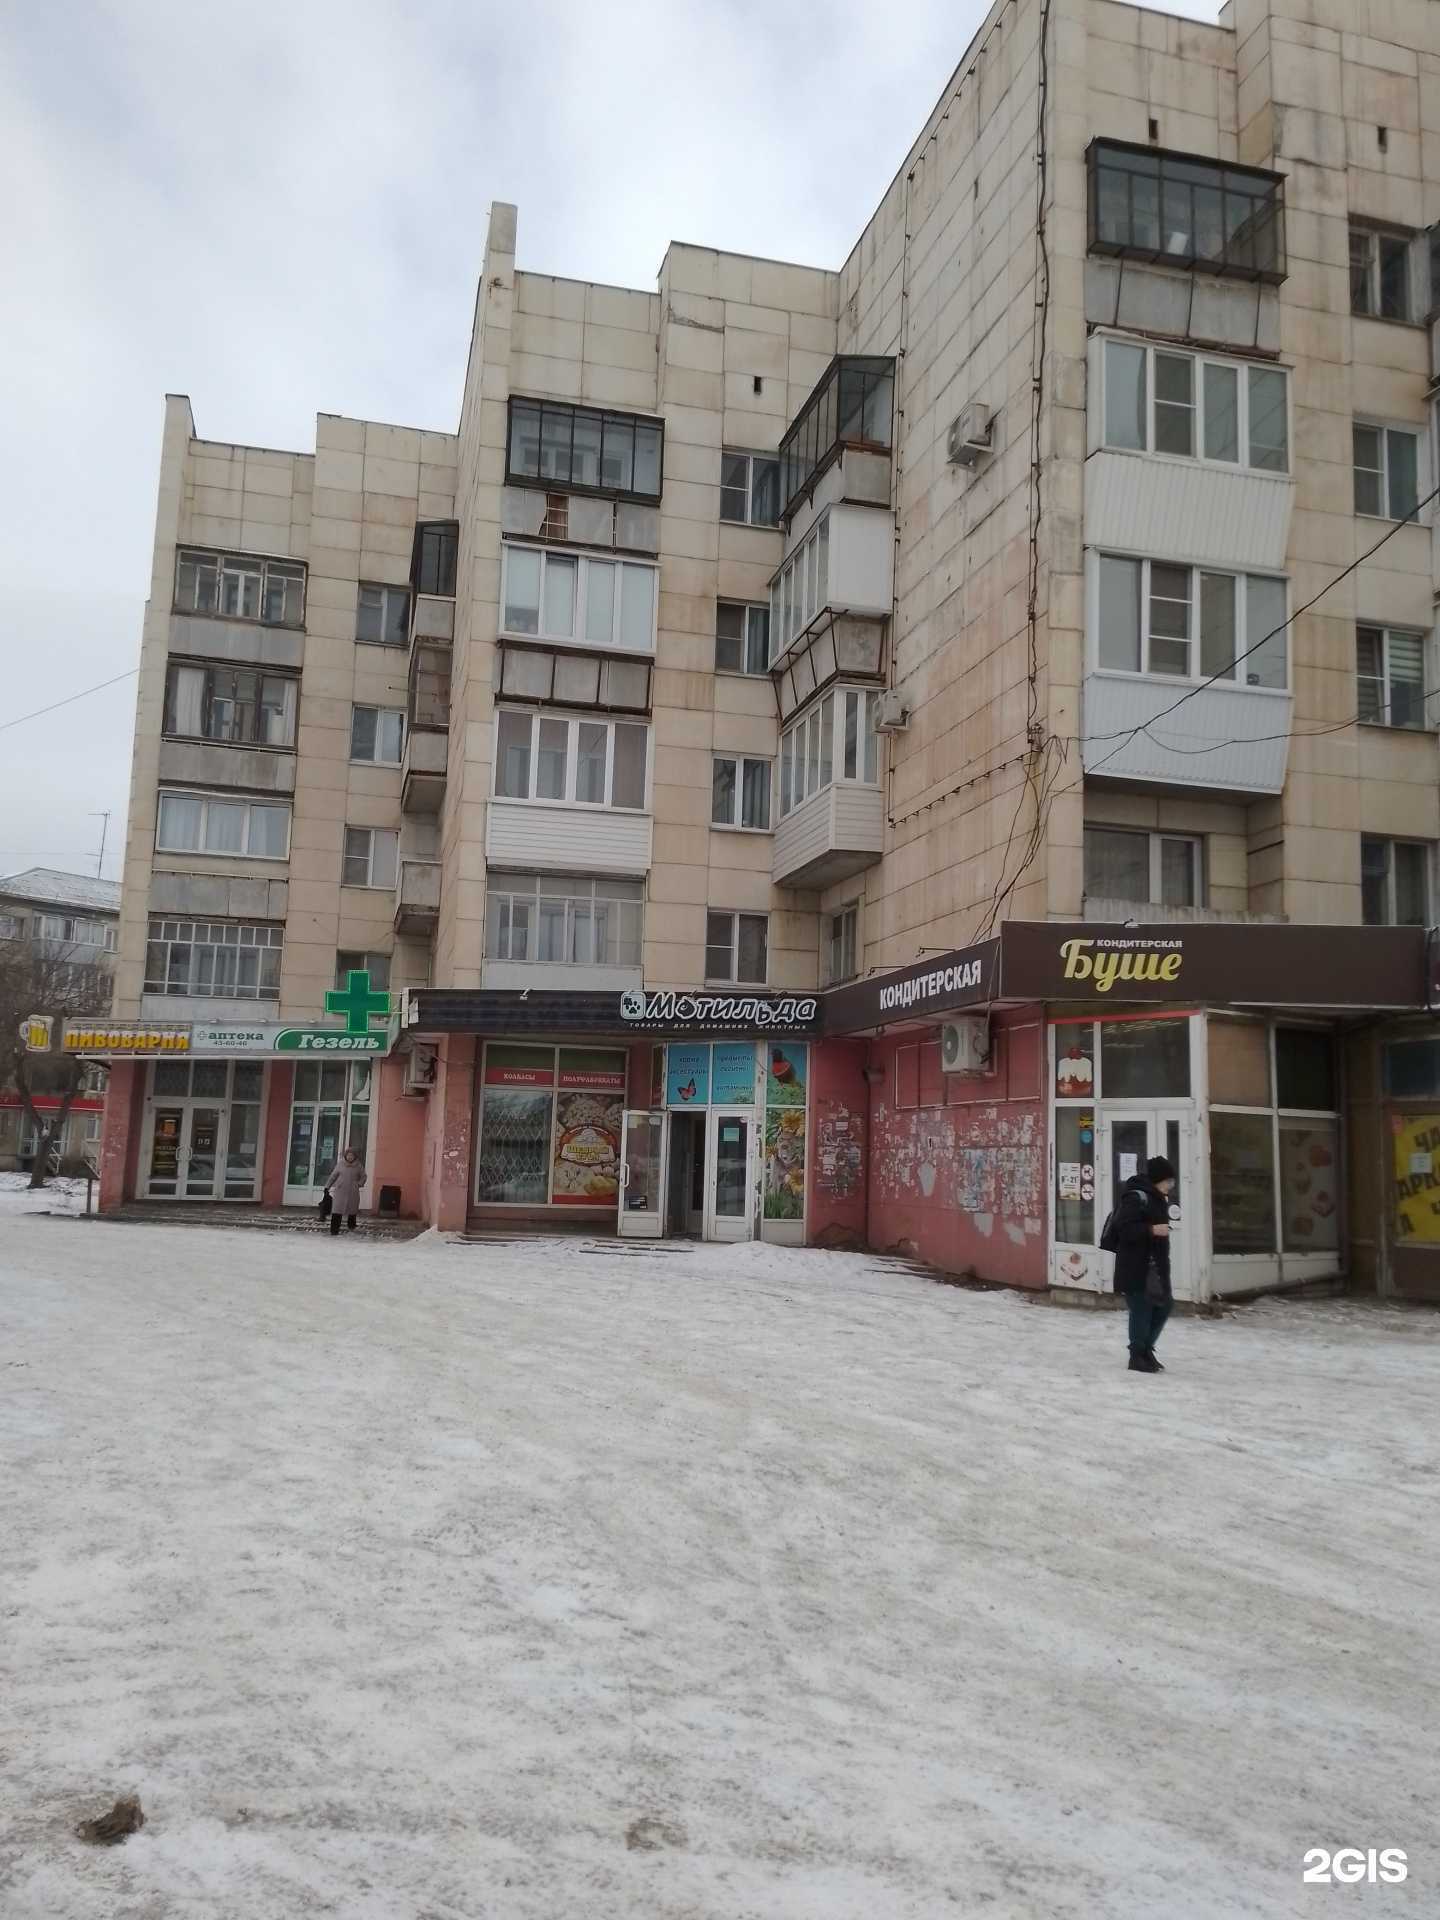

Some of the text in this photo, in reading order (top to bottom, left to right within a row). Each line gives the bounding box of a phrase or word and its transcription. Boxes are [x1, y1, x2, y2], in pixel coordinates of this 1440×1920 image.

[1096, 938, 1183, 949] КОНДИТЕРСКАЯ
[1059, 938, 1183, 992] Буше
[879, 958, 982, 1010] КОНДИТЕРСКАЯ
[645, 991, 818, 1025] Мотильда
[64, 1029, 191, 1051] ПИВОВАРНЯ
[207, 1030, 265, 1041] аптека
[298, 1034, 380, 1049] Гезель
